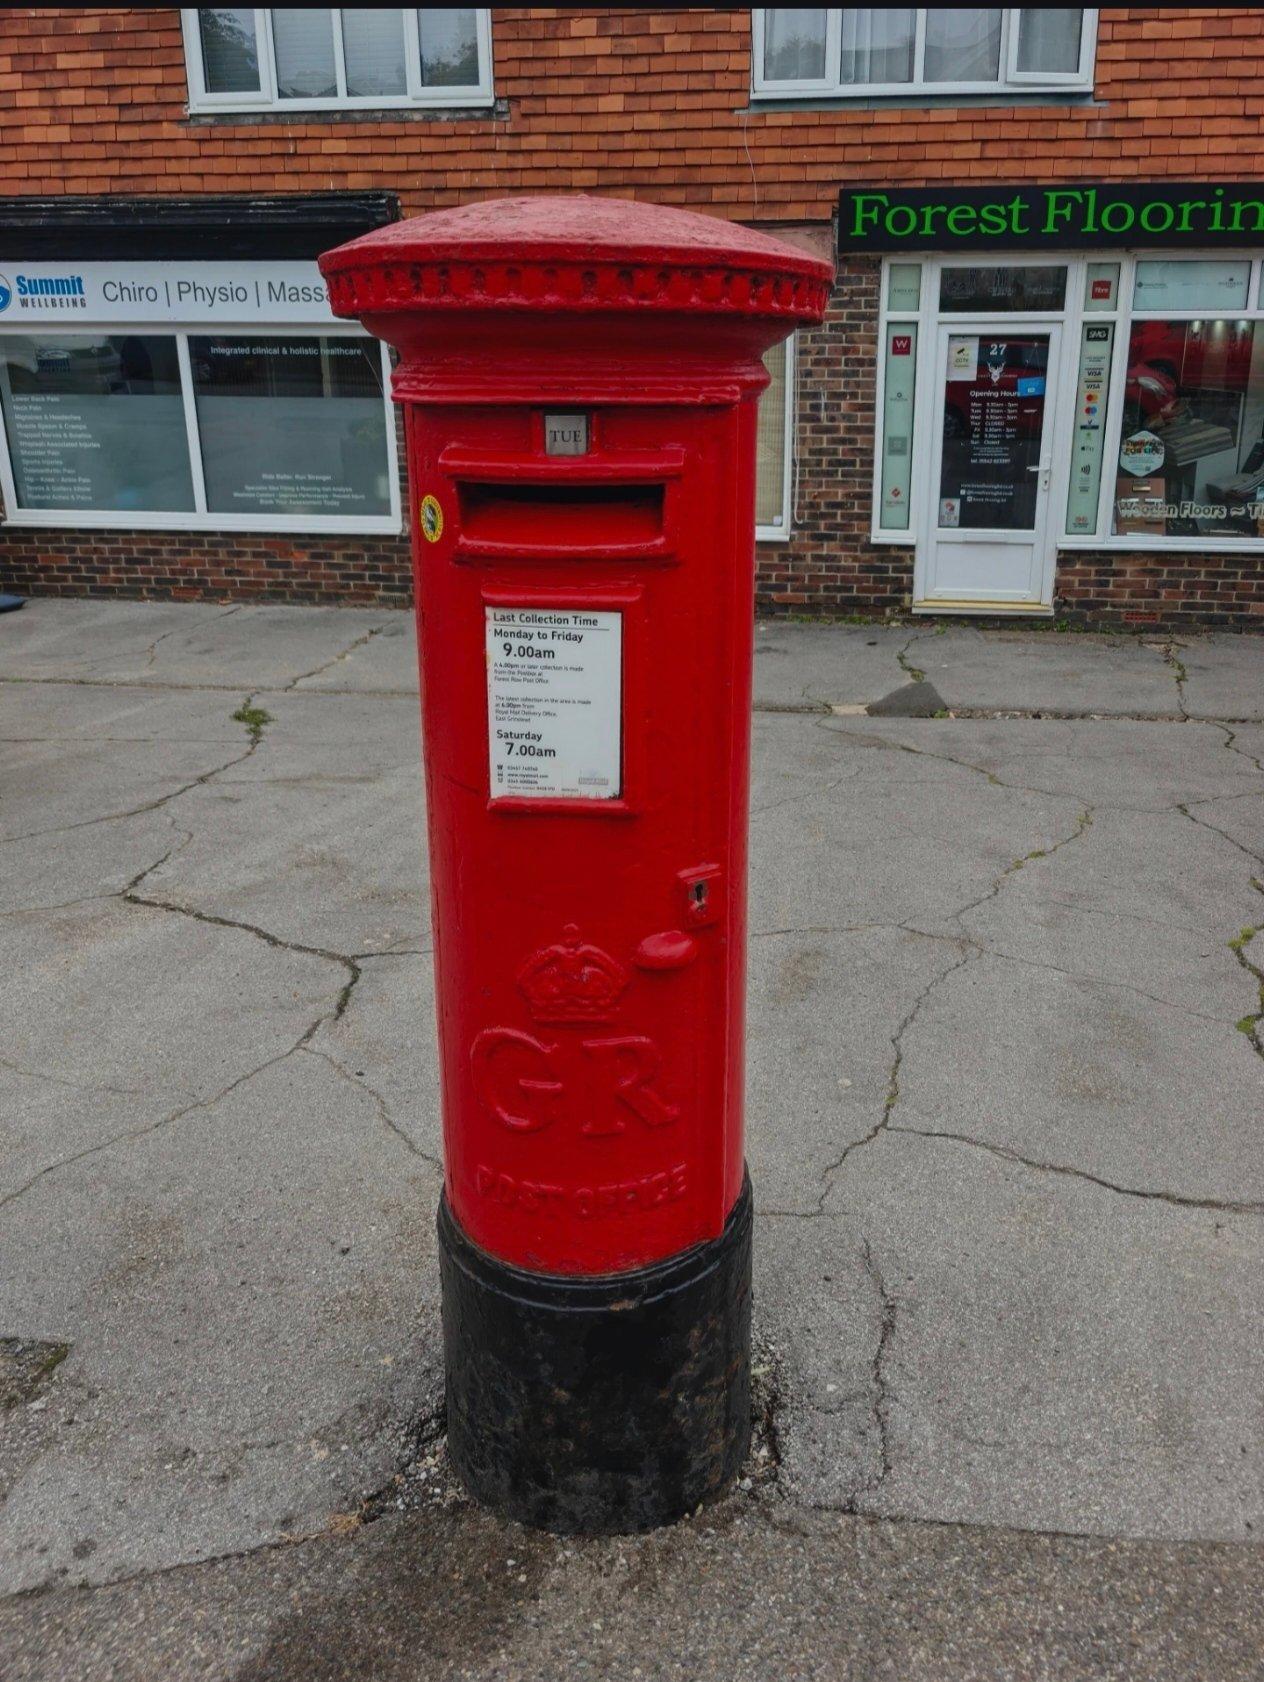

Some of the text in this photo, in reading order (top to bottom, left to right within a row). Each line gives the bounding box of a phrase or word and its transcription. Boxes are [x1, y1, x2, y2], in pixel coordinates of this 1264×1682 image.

[850, 188, 1264, 236] Forest Floorin
[16, 276, 84, 295] Summit
[103, 281, 157, 302] Chiro
[178, 281, 247, 307] Physio
[268, 281, 329, 302] Mass
[20, 298, 86, 308] WELLBEING
[211, 346, 362, 356] Integrated clinical & holistic healthcare
[990, 344, 1007, 355] 27
[970, 390, 998, 398] Opening
[550, 430, 582, 442] TUE
[1120, 502, 1177, 517] Wooden
[1182, 502, 1228, 518] Floors
[494, 613, 598, 626] Last Collection Time
[494, 629, 583, 643] Monday to Friday
[503, 642, 555, 659] 9.00am
[496, 730, 542, 741] Saturday
[505, 742, 556, 757] 7.00am
